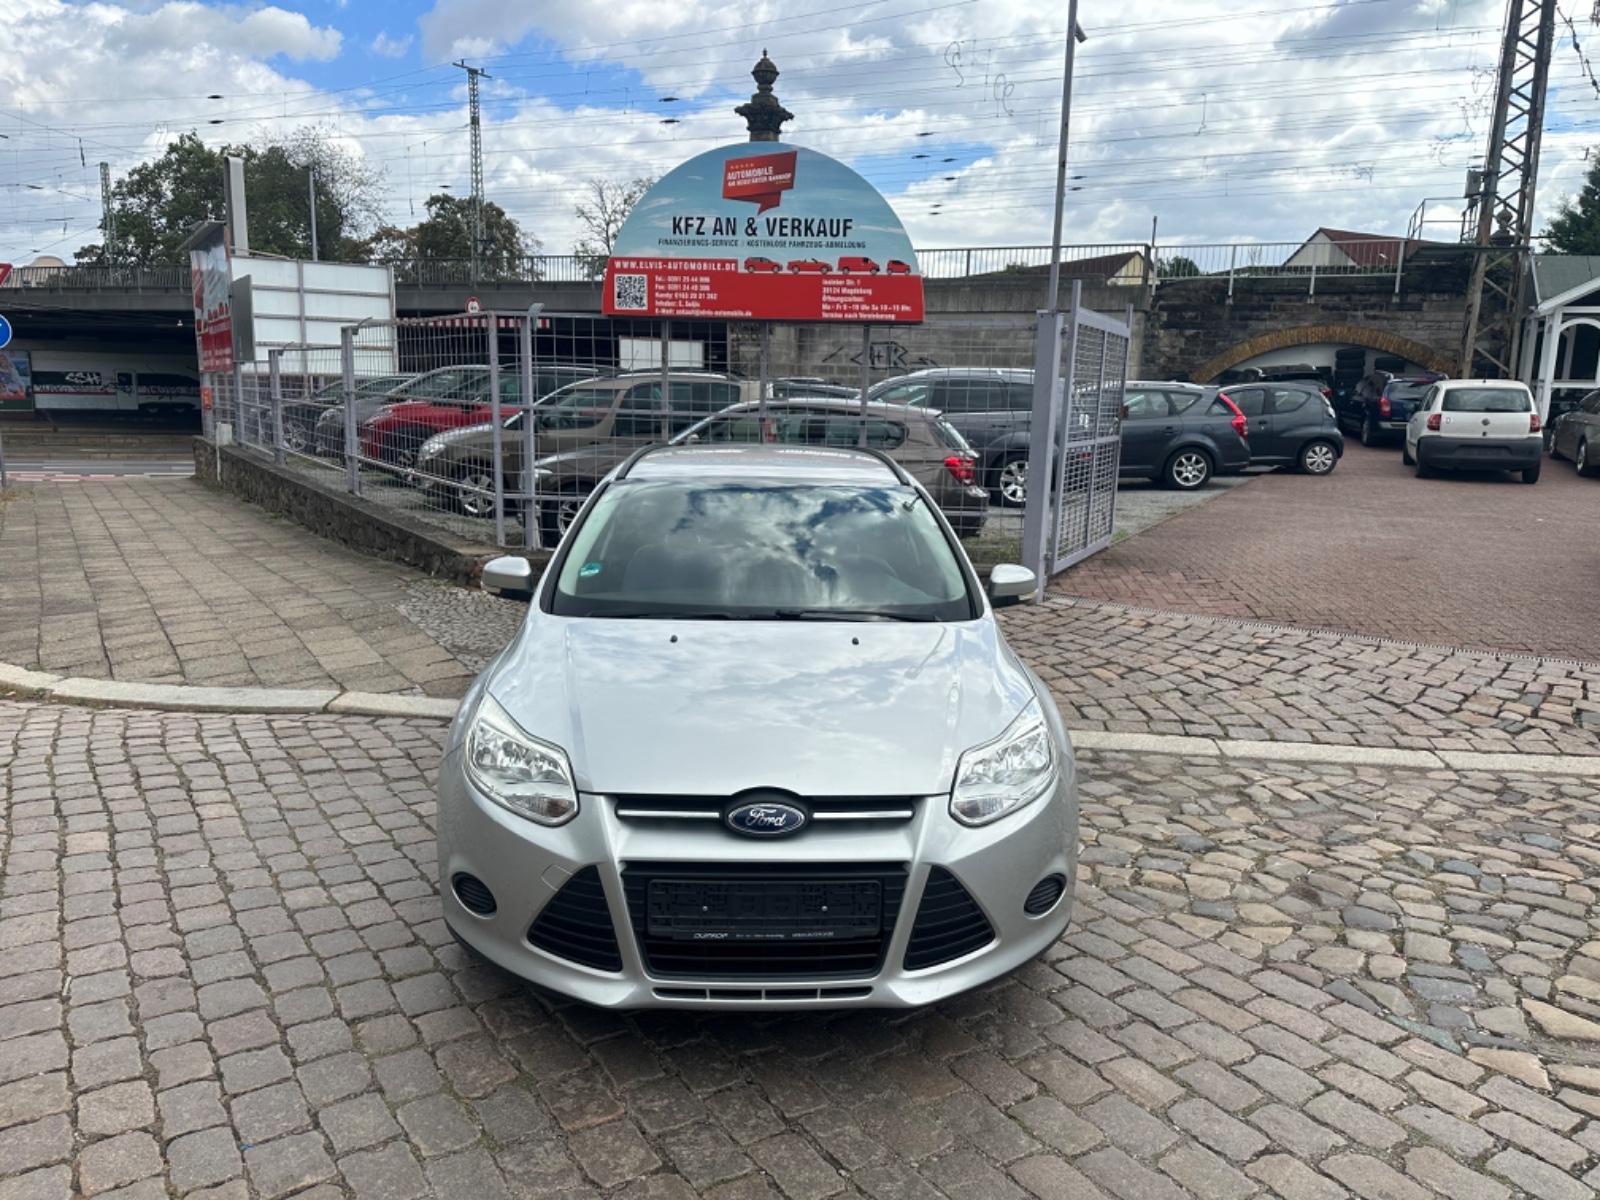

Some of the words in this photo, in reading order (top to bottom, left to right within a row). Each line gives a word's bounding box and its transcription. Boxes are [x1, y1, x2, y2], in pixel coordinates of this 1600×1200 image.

[727, 166, 774, 180] AUTOMOBILE
[672, 216, 706, 236] KFZ
[712, 216, 737, 236] AN
[744, 216, 758, 237] &
[765, 217, 853, 238] VERKAUF
[658, 238, 738, 247] FINANZIERUNGS-SERVICE
[746, 239, 787, 248] KOSTENLOSE
[788, 240, 866, 249] FAHRZEUG-ABMELDUNG
[614, 261, 736, 272] WWW.ELVIS-AUTOMOBILE.DE
[745, 807, 787, 827] Ford
